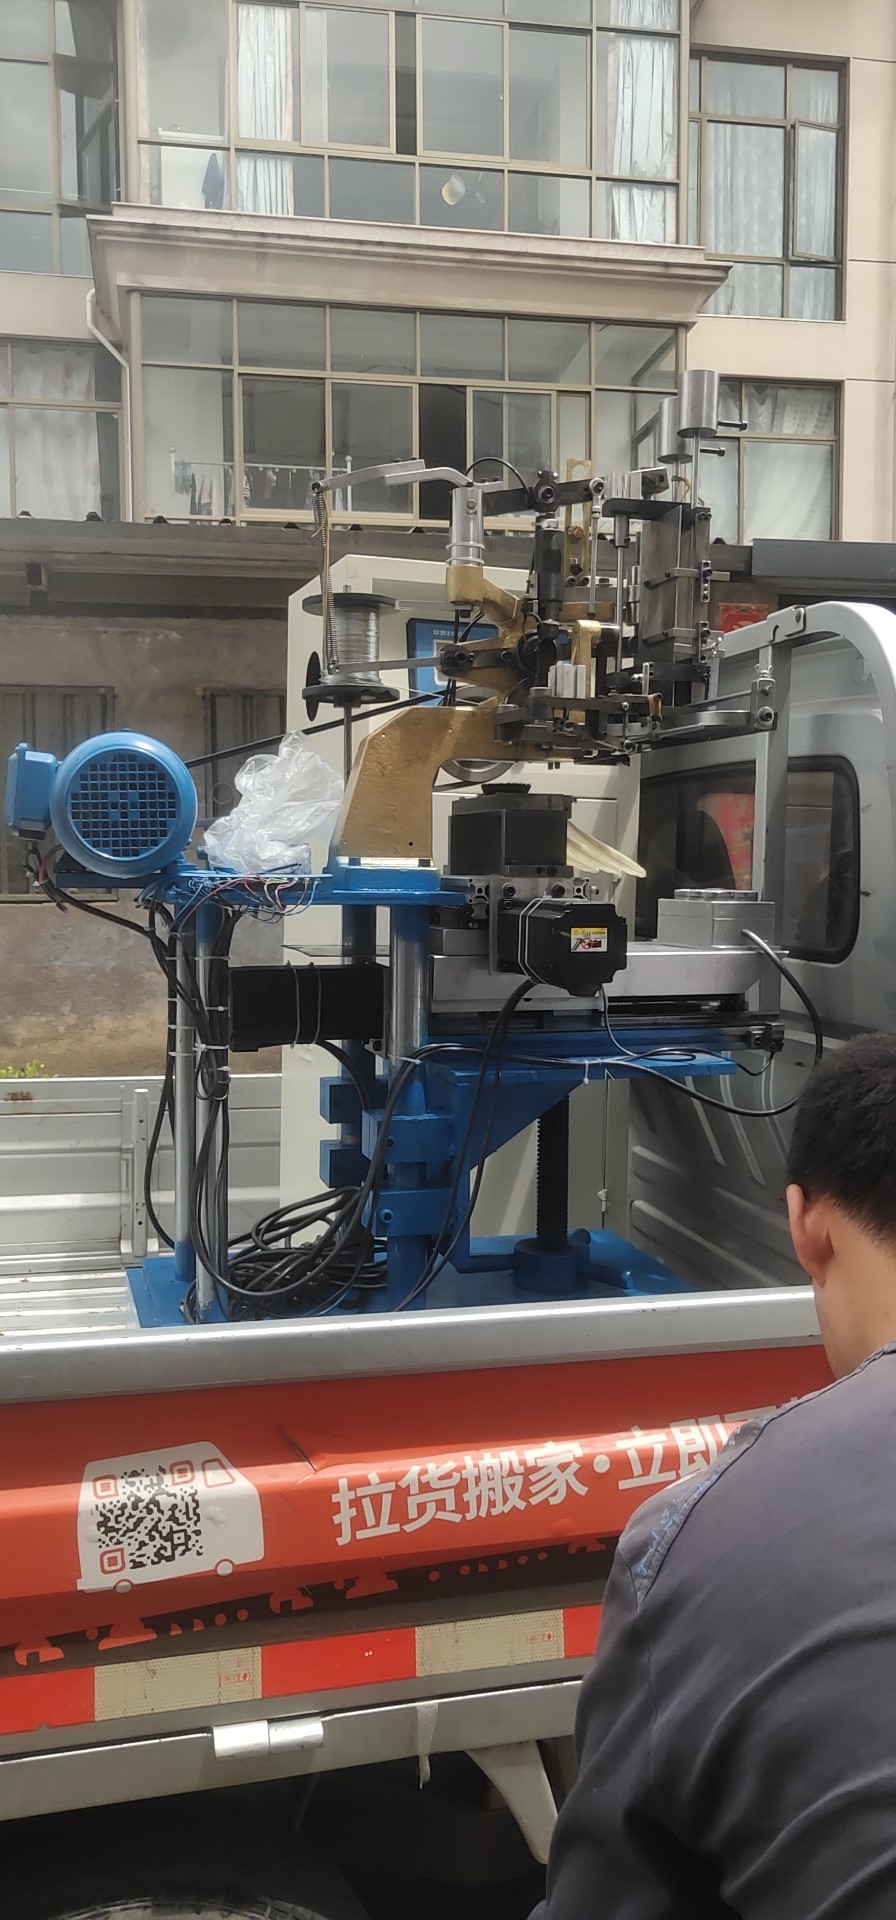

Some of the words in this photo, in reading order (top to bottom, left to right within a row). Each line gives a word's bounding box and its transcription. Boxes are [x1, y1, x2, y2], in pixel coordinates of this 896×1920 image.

[331, 1397, 798, 1546] 拉货搬家·立即
